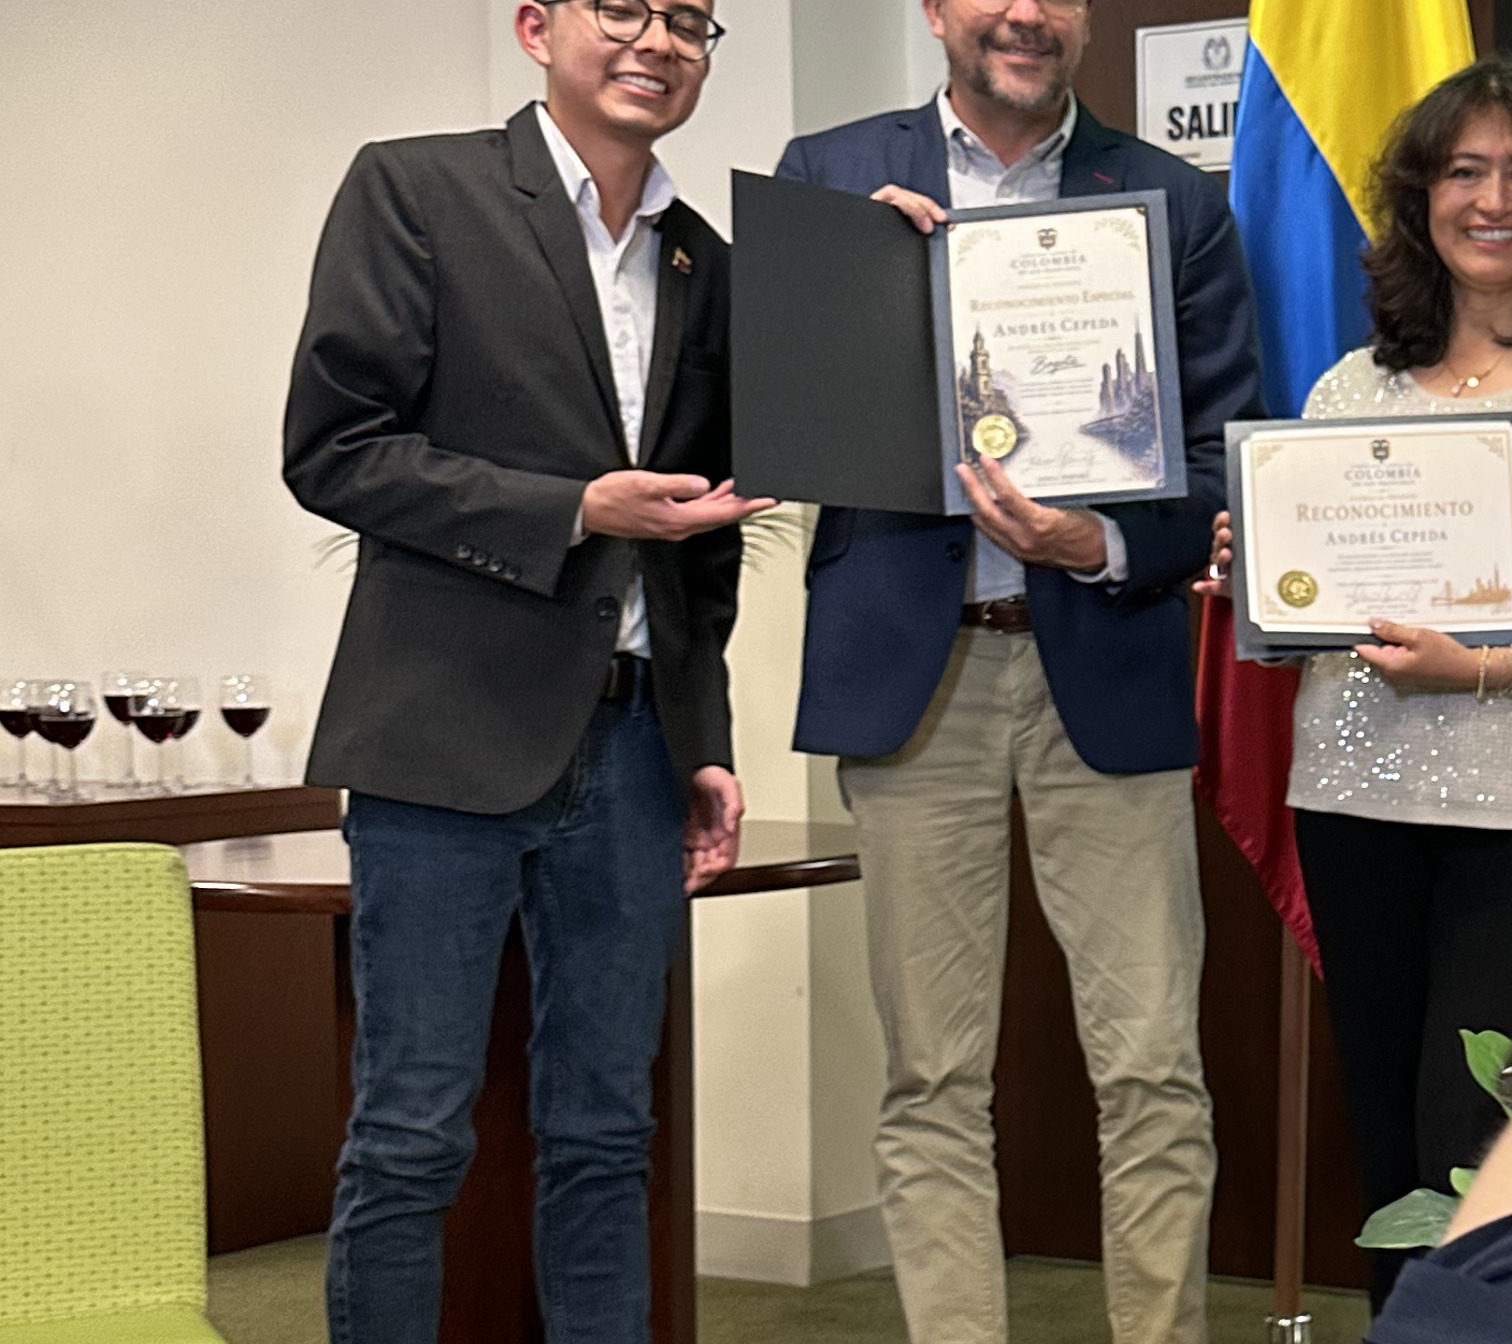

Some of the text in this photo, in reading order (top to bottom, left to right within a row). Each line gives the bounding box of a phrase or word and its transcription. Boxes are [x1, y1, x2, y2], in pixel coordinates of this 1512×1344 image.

[1344, 468, 1421, 481] COLOMBIA
[1297, 501, 1474, 522] RECONOCIMIENTO
[1390, 529, 1448, 543] CEPEDA
